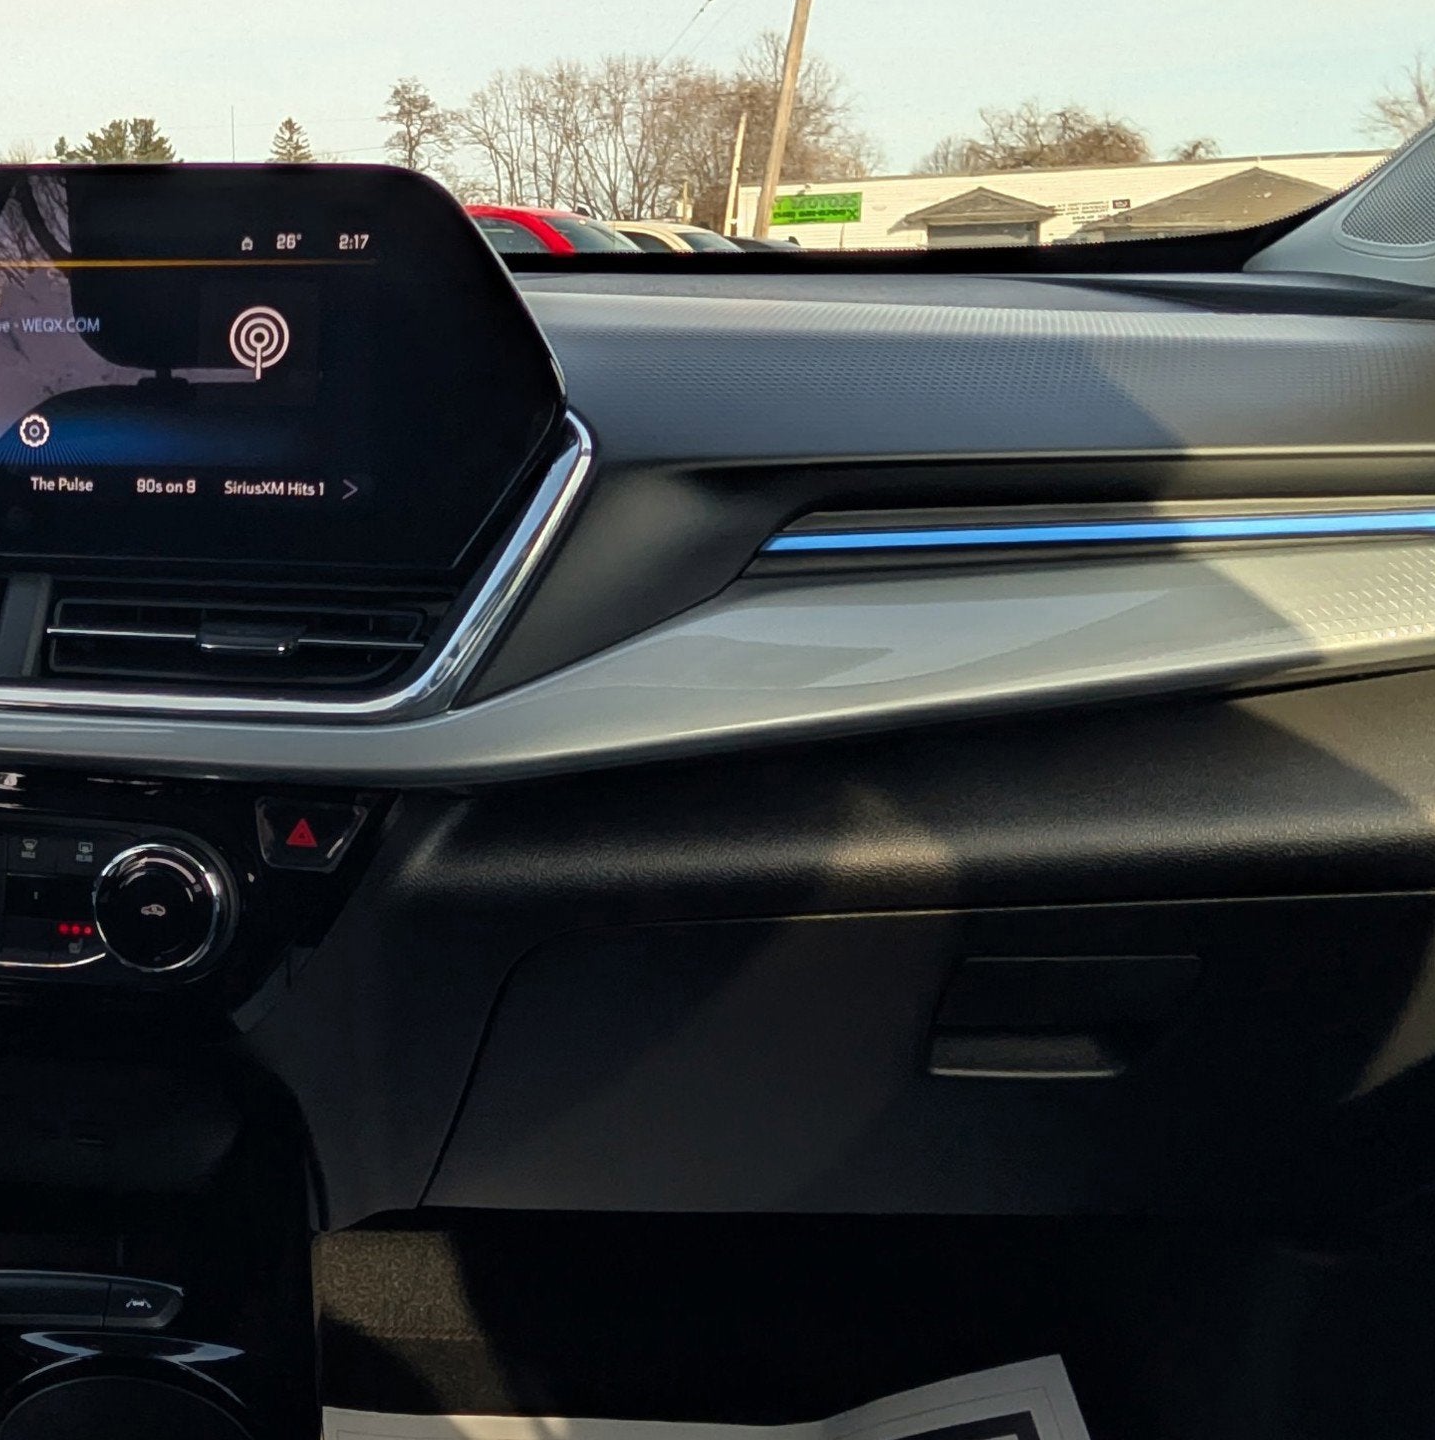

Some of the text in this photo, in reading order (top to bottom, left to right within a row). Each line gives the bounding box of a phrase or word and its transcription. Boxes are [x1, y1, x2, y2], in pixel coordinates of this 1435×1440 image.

[338, 233, 370, 250] 2:17
[21, 317, 100, 334] WEQX.COM
[30, 476, 94, 492] The Pulse
[165, 482, 183, 494] on
[224, 480, 325, 496] SiriusXM Hits 1
